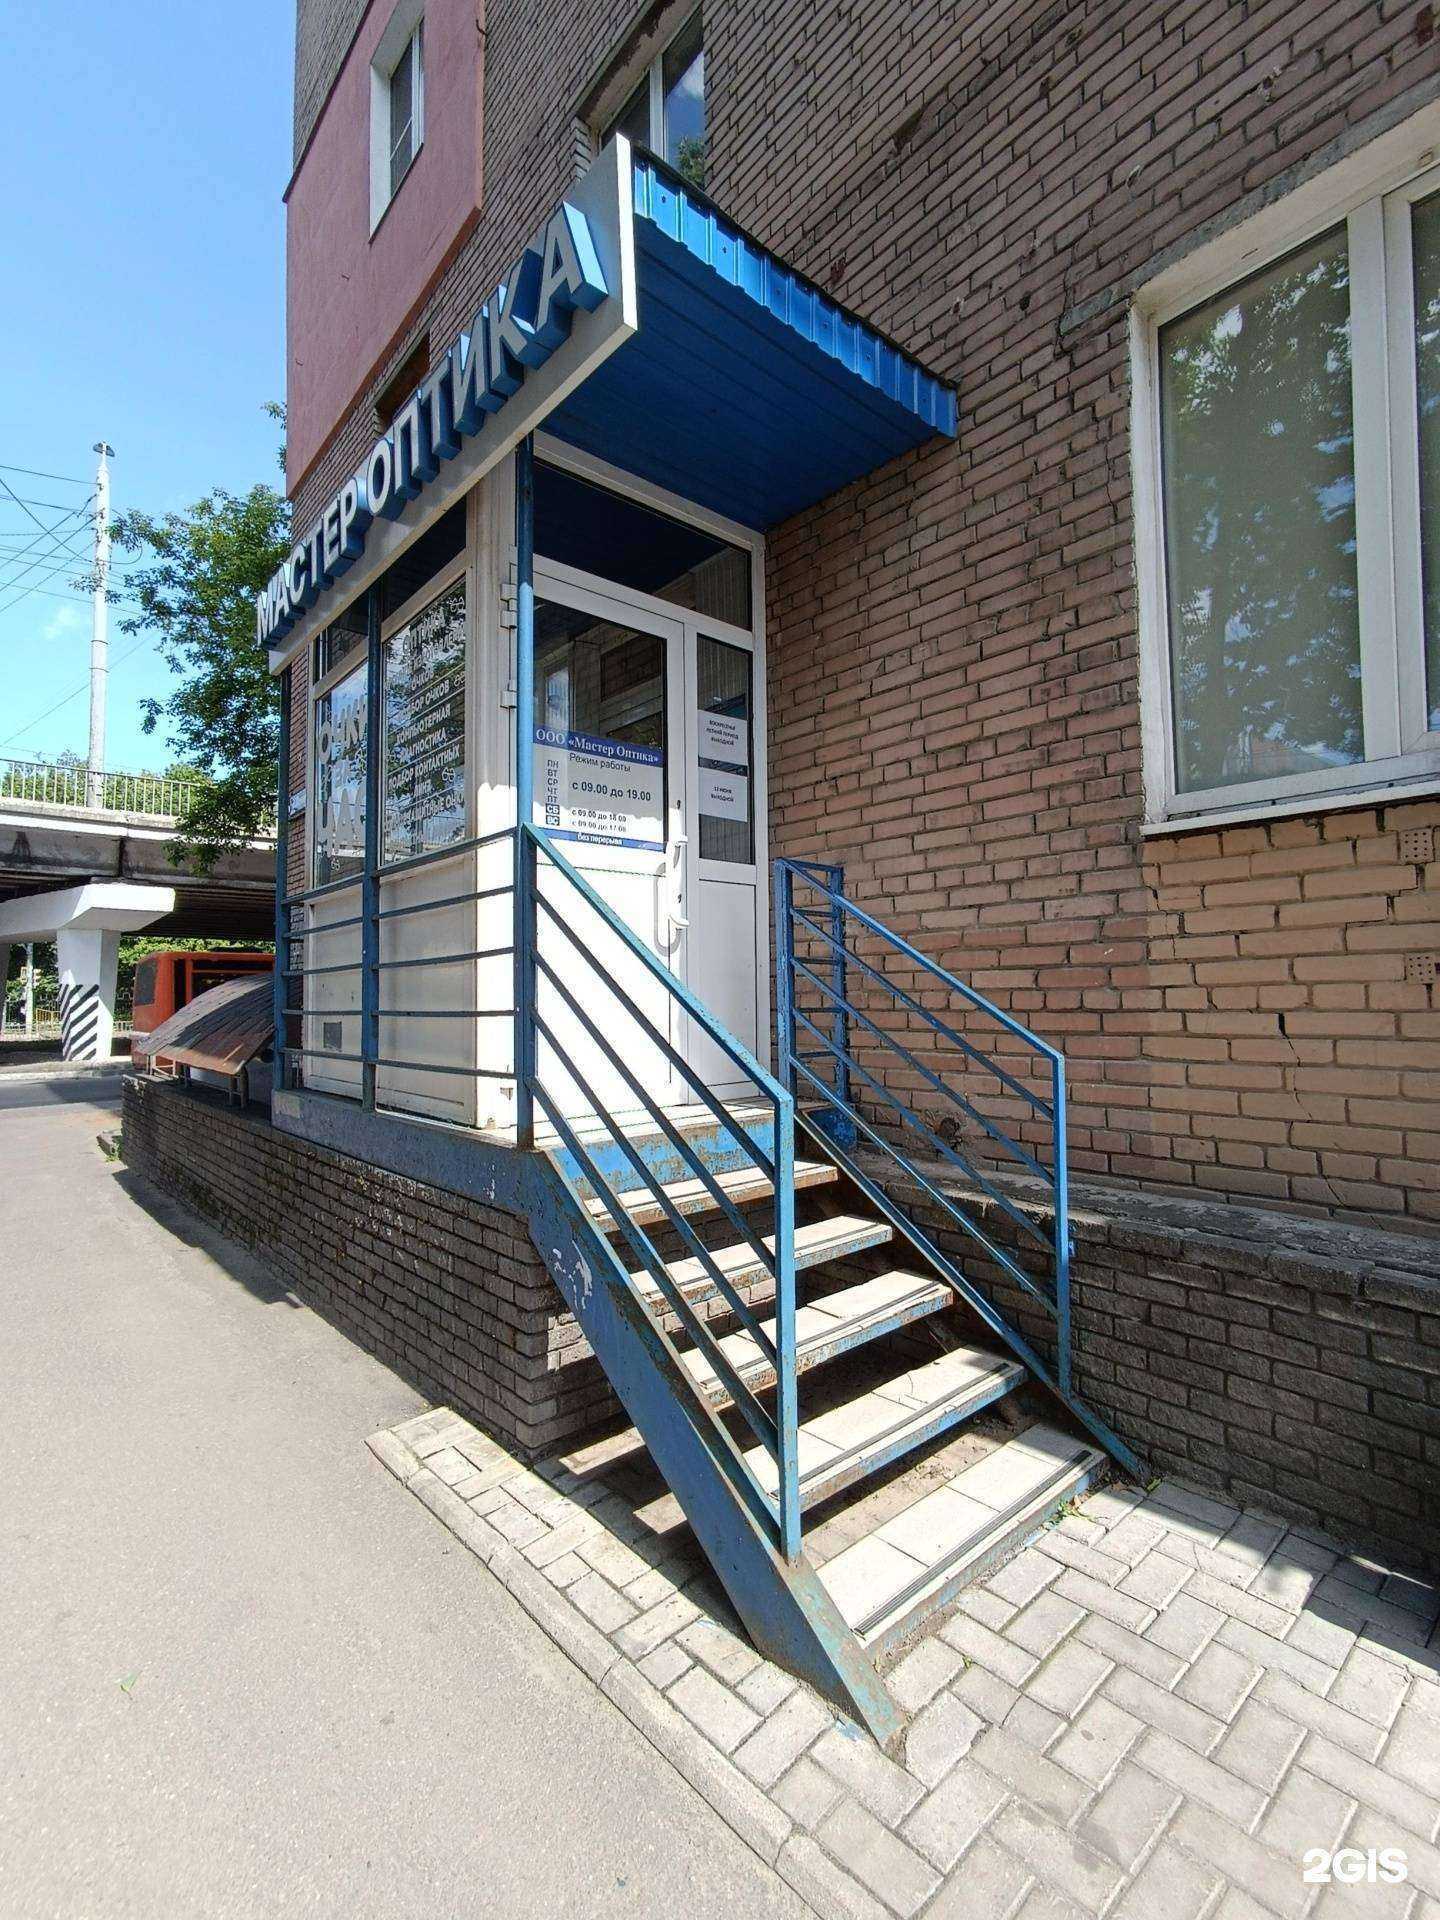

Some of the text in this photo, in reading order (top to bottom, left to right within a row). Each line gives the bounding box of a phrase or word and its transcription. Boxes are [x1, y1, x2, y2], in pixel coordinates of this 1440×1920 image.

[257, 202, 604, 648] МАСТЕР ОПТИКА
[425, 679, 450, 705] ОЧКОВ
[396, 703, 451, 743] КОМПЬЮТЕРНАЯ
[536, 728, 659, 762] ООО «Мастер Оптика»
[415, 744, 460, 777] КОНТАКТНЫХ
[547, 759, 559, 769] ПН
[569, 752, 631, 773] Режим работы
[547, 769, 557, 777] ВТ
[547, 777, 558, 787] СР
[547, 787, 557, 795] ЧТ
[581, 781, 608, 795] 09.00
[610, 788, 623, 799] до
[627, 788, 651, 802] 19.00
[547, 795, 557, 803] ПТ
[547, 805, 559, 814] СБ
[547, 816, 559, 826] ВС
